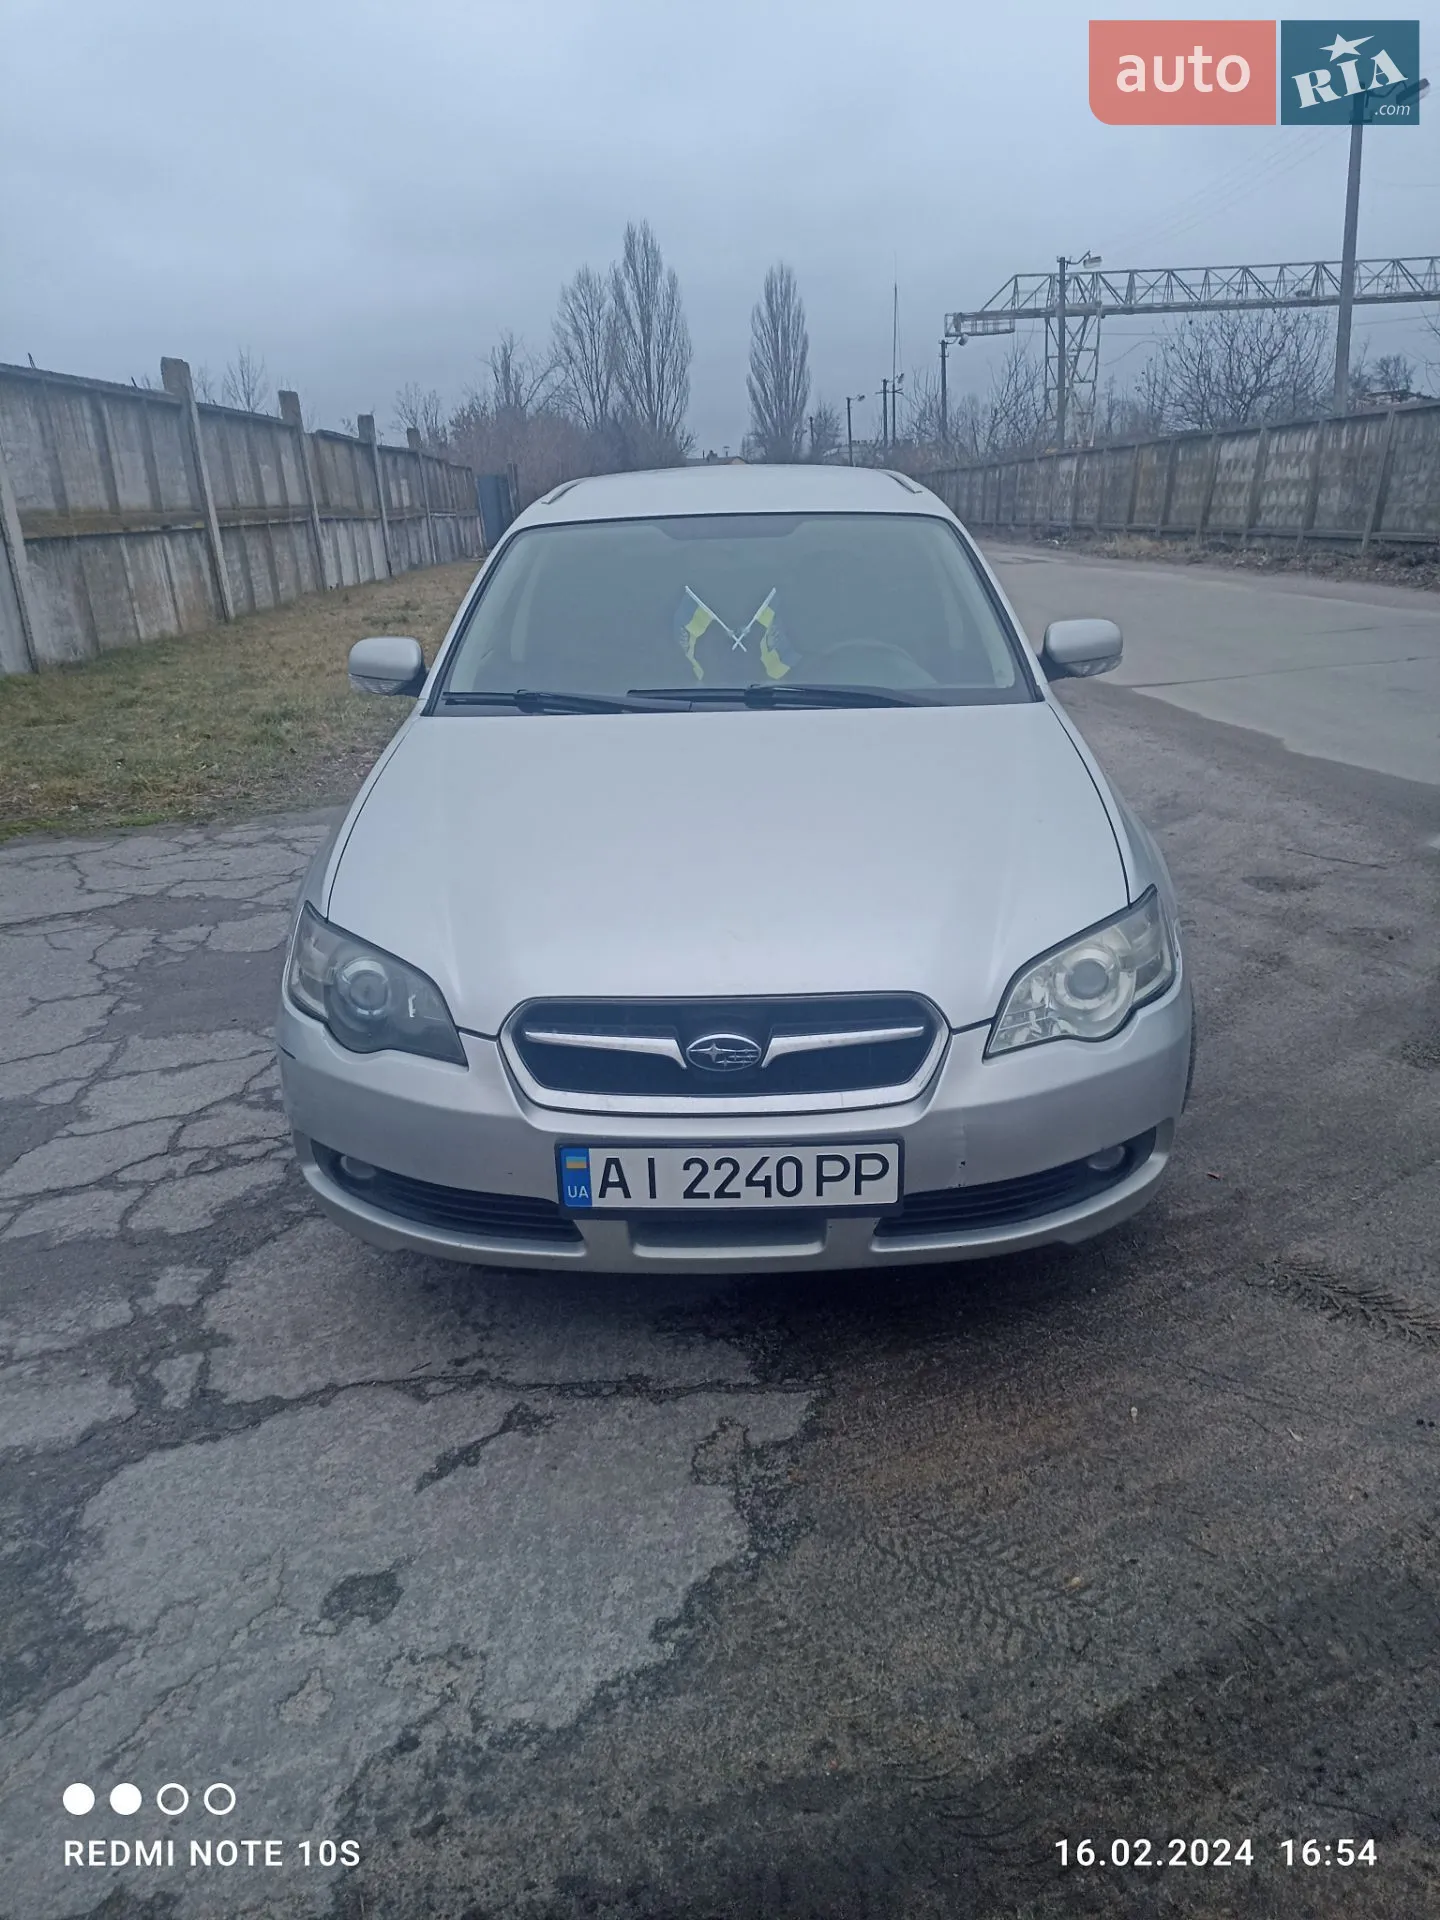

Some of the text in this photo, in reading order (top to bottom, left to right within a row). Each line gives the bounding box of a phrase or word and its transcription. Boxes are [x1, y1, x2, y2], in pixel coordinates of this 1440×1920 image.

[598, 1153, 890, 1200] AI 2240 PP
[567, 1185, 589, 1200] UA
